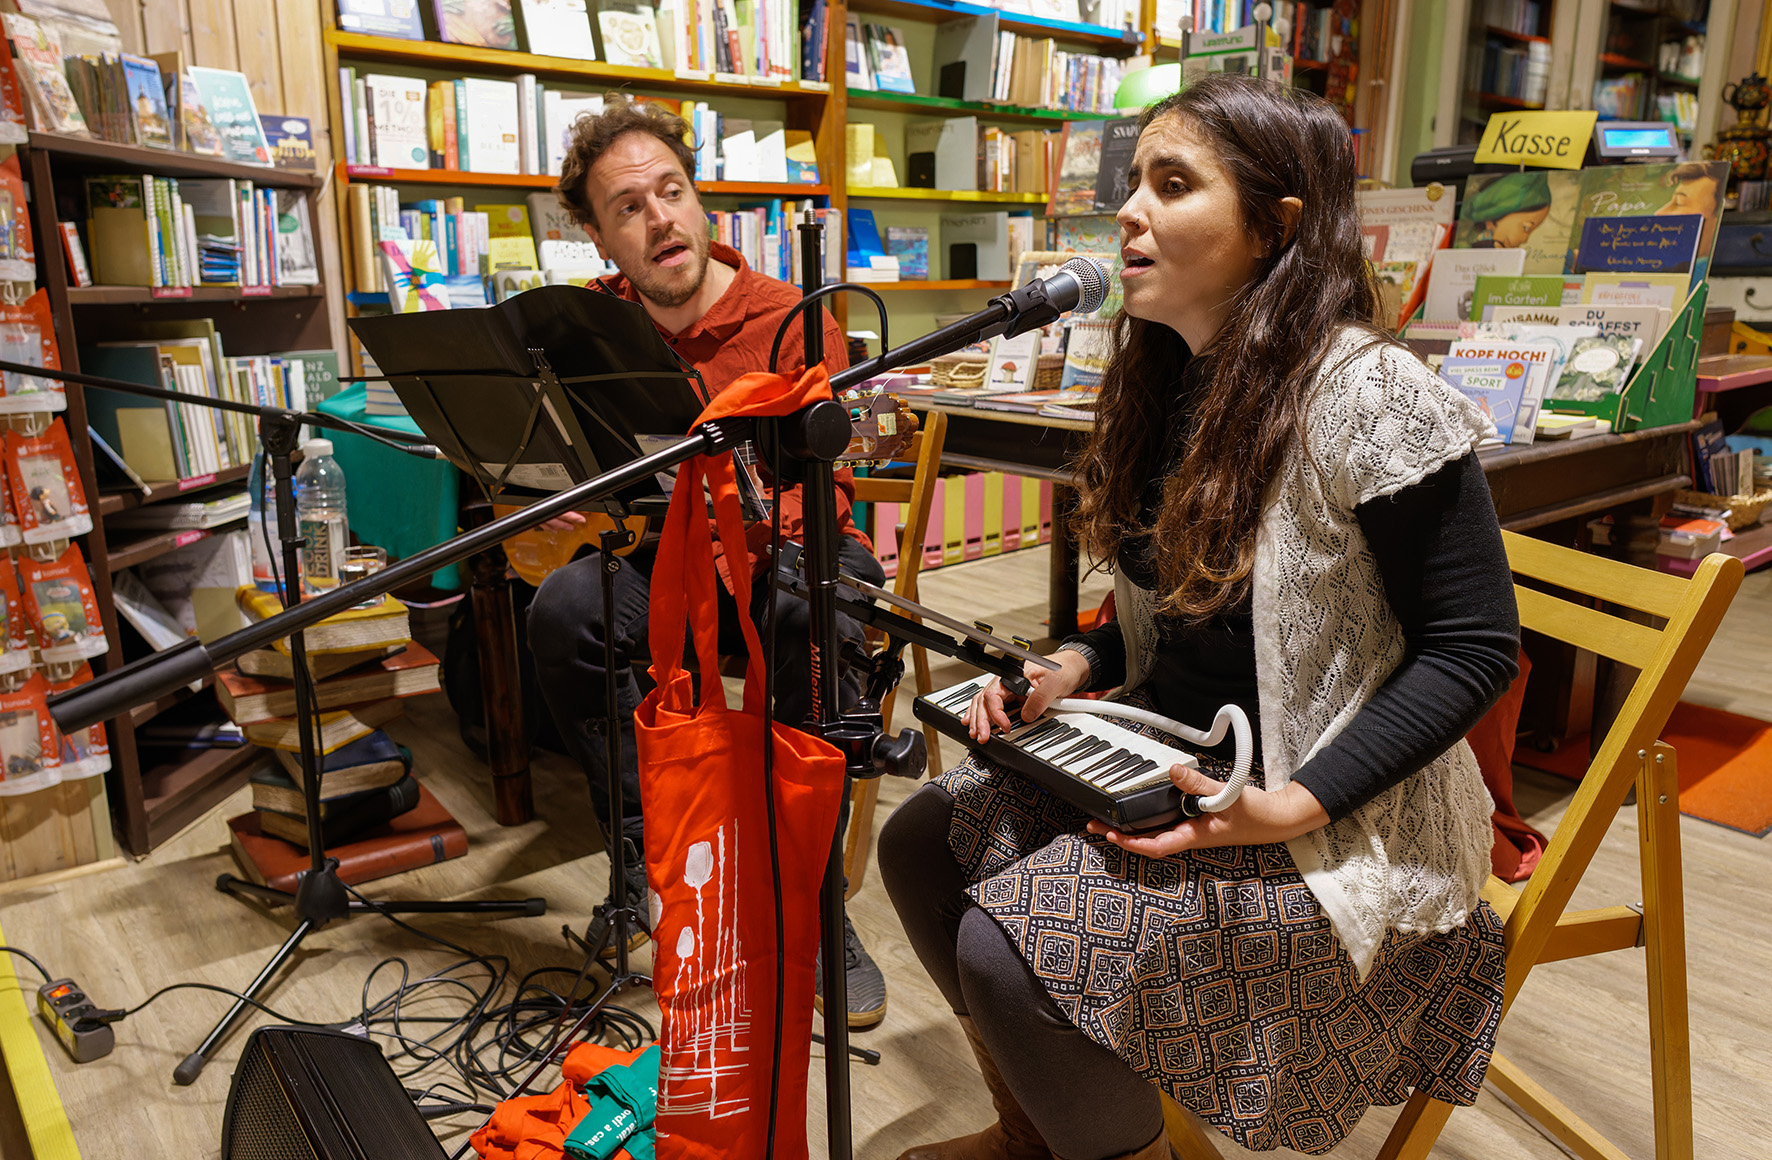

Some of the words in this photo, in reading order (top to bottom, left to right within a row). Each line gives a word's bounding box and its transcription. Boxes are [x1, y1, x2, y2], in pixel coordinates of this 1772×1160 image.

[1491, 119, 1571, 156] Kasse
[1590, 191, 1653, 217] Papa
[1487, 293, 1502, 304] Im
[1504, 293, 1548, 305] Garten!
[1586, 310, 1605, 319] DU
[1455, 348, 1494, 359] KOPF
[1496, 350, 1546, 362] HOCH!
[1466, 376, 1503, 388] SPORT
[314, 525, 329, 576] DRINK
[604, 1124, 612, 1132] a
